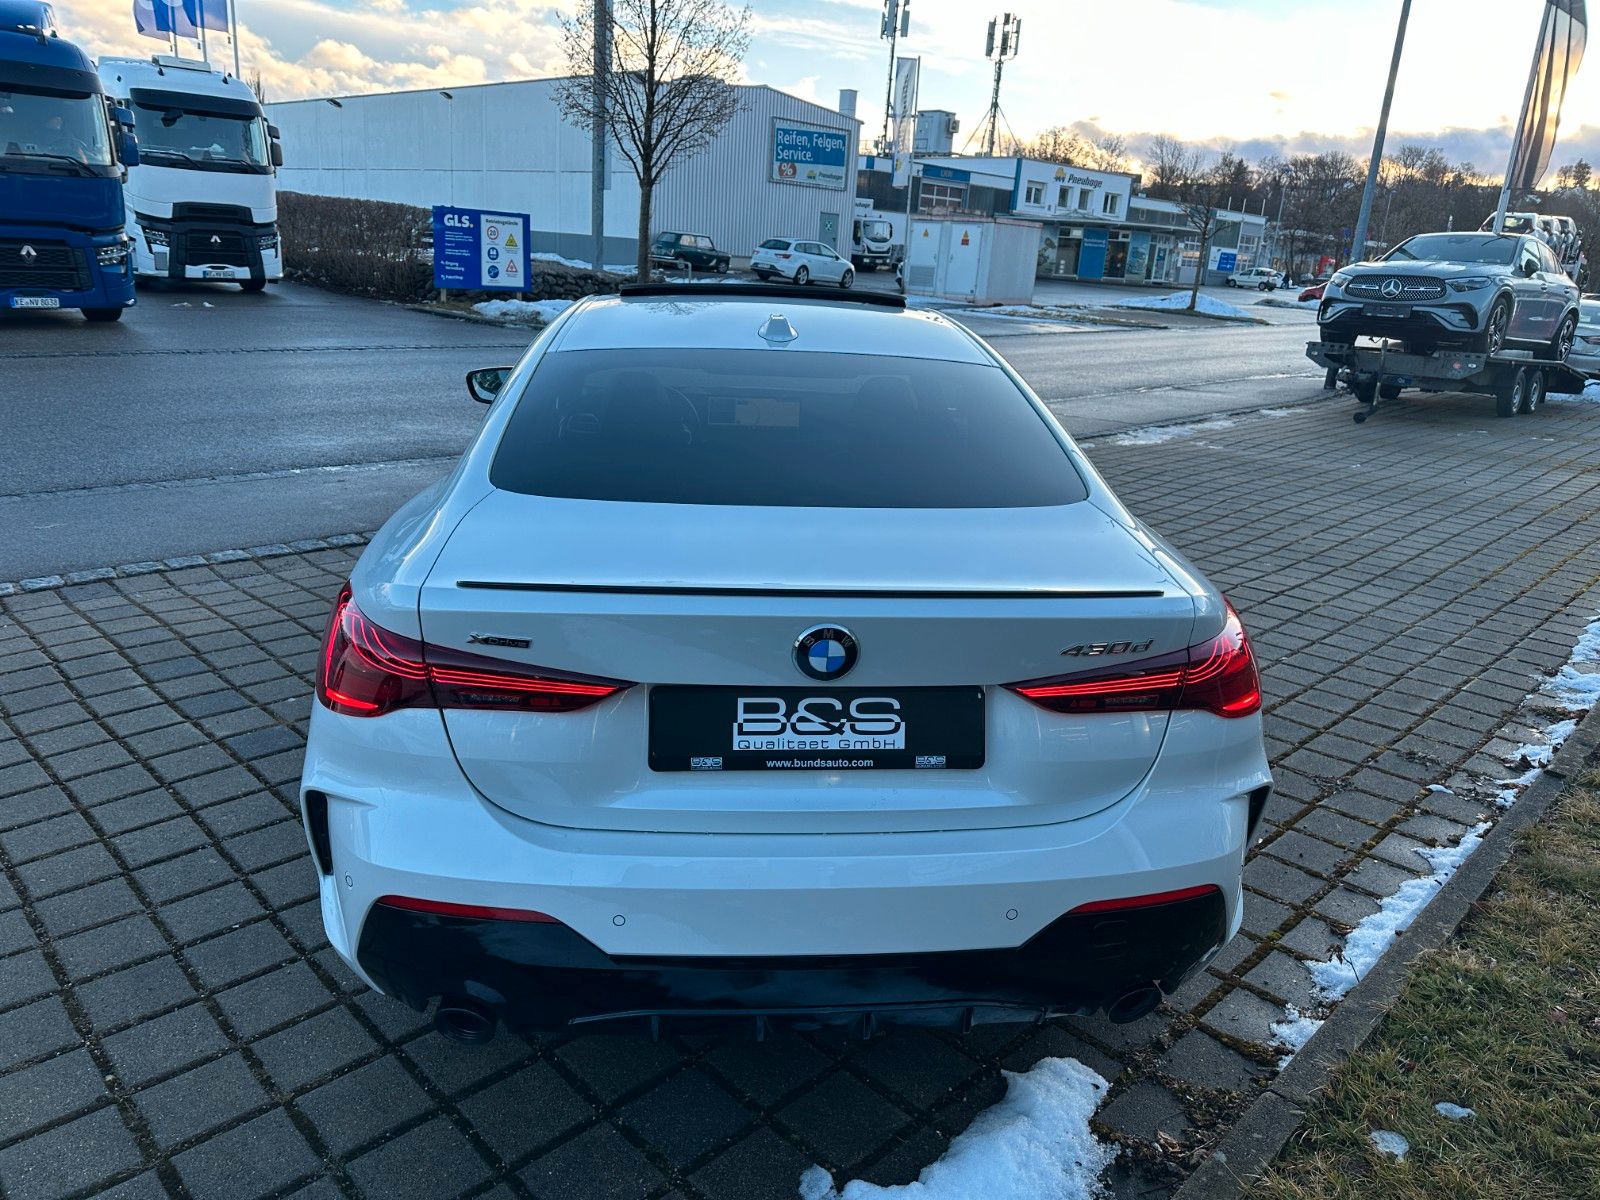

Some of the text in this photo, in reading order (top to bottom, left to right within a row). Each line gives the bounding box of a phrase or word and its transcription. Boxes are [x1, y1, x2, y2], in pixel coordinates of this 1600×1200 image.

[777, 130, 845, 152] Reifen, Felgen,
[777, 146, 813, 161] Service.
[1067, 174, 1103, 188] Pneuhage
[29, 298, 39, 306] NV
[802, 628, 853, 647] BMW
[1059, 638, 1154, 657] 430d
[737, 697, 901, 736] B&S
[737, 739, 829, 750] Qualitaet
[766, 758, 874, 768] www.bundsauto.com
